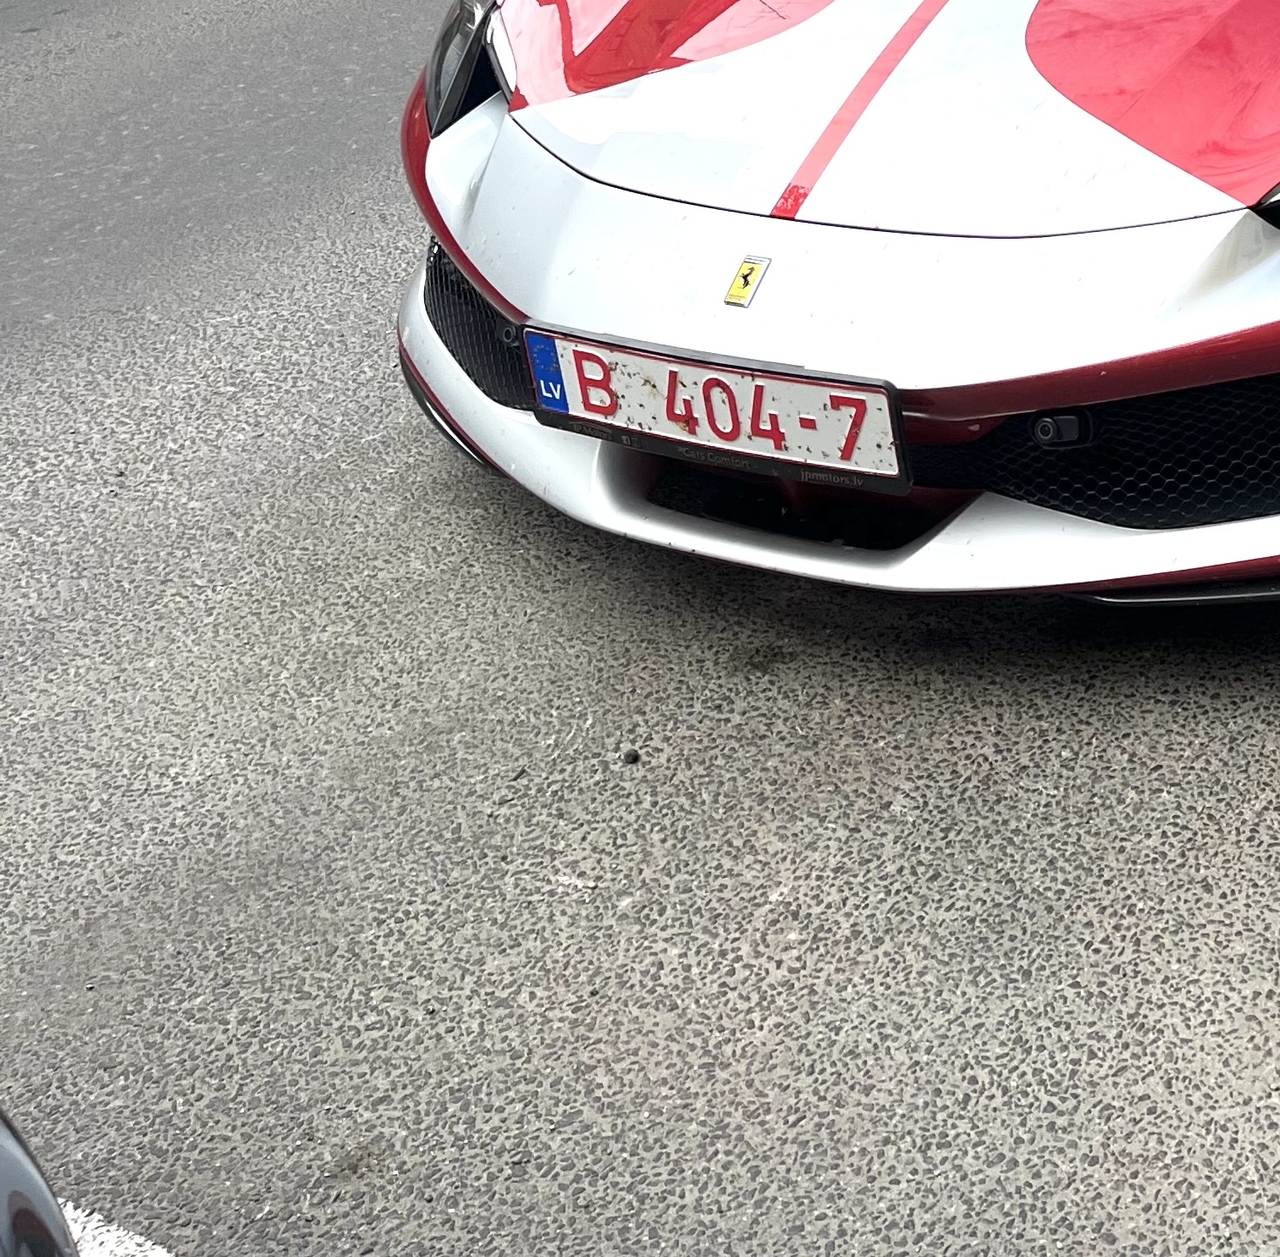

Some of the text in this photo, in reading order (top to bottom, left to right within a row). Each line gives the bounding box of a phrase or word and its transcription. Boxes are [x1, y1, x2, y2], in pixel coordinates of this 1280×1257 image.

[540, 348, 867, 460] LV B 404-7
